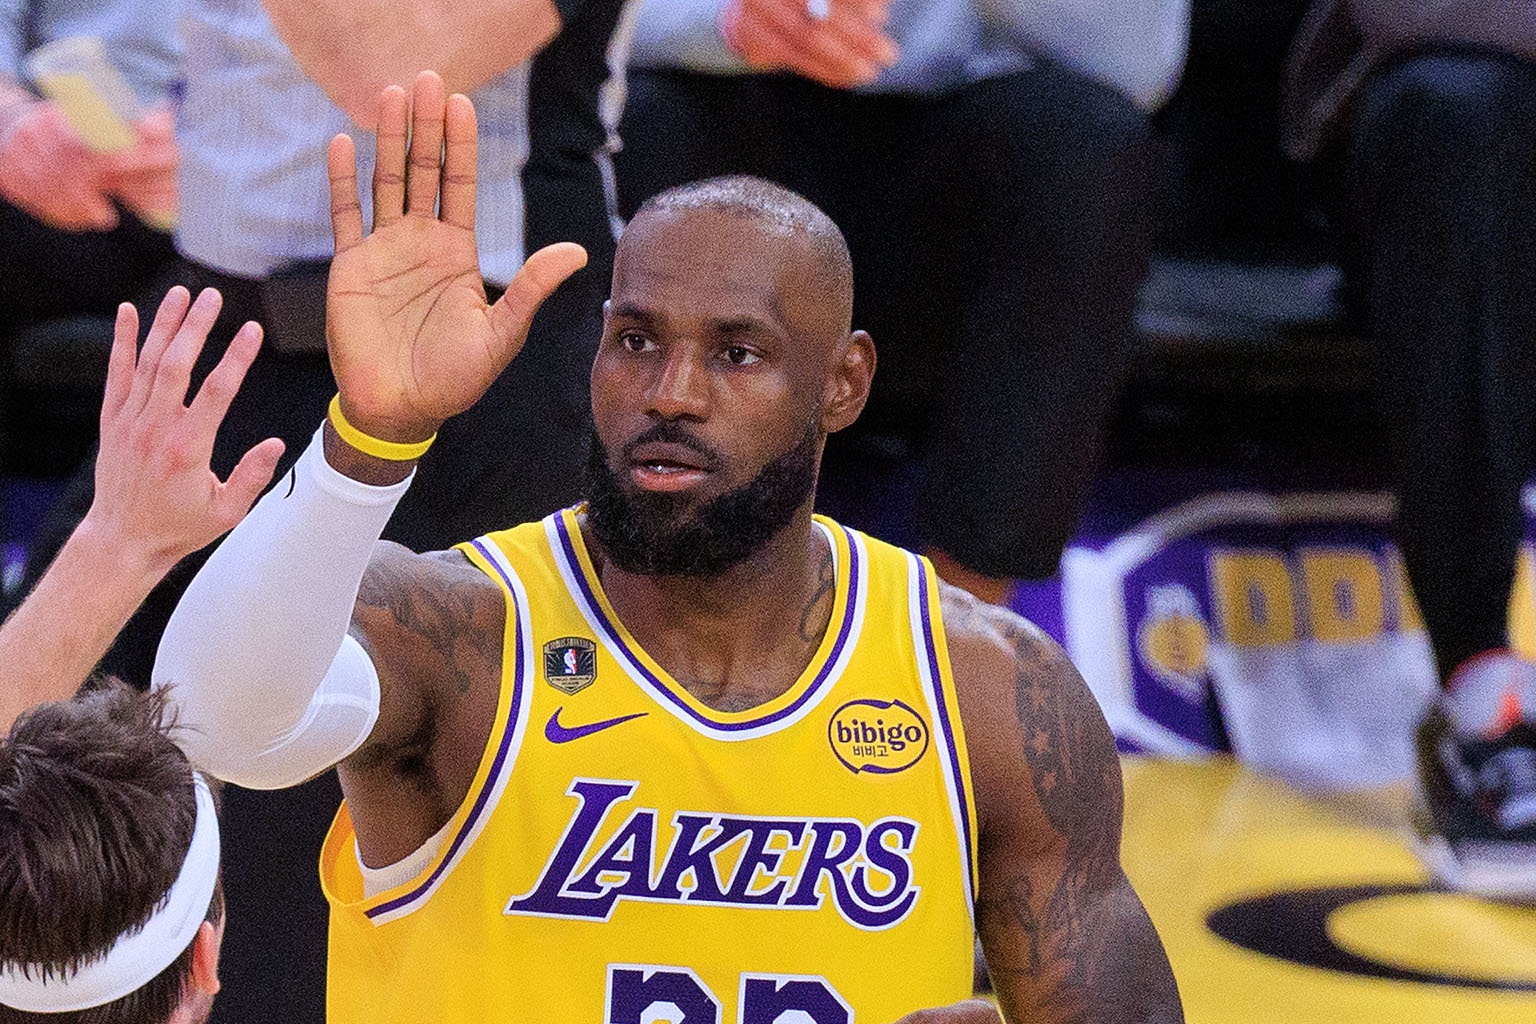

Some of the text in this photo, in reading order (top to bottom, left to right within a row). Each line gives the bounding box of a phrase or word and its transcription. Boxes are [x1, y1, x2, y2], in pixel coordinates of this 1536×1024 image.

[836, 718, 922, 752] bibigo
[851, 744, 889, 758] 비비고
[503, 776, 922, 932] LAKERS
